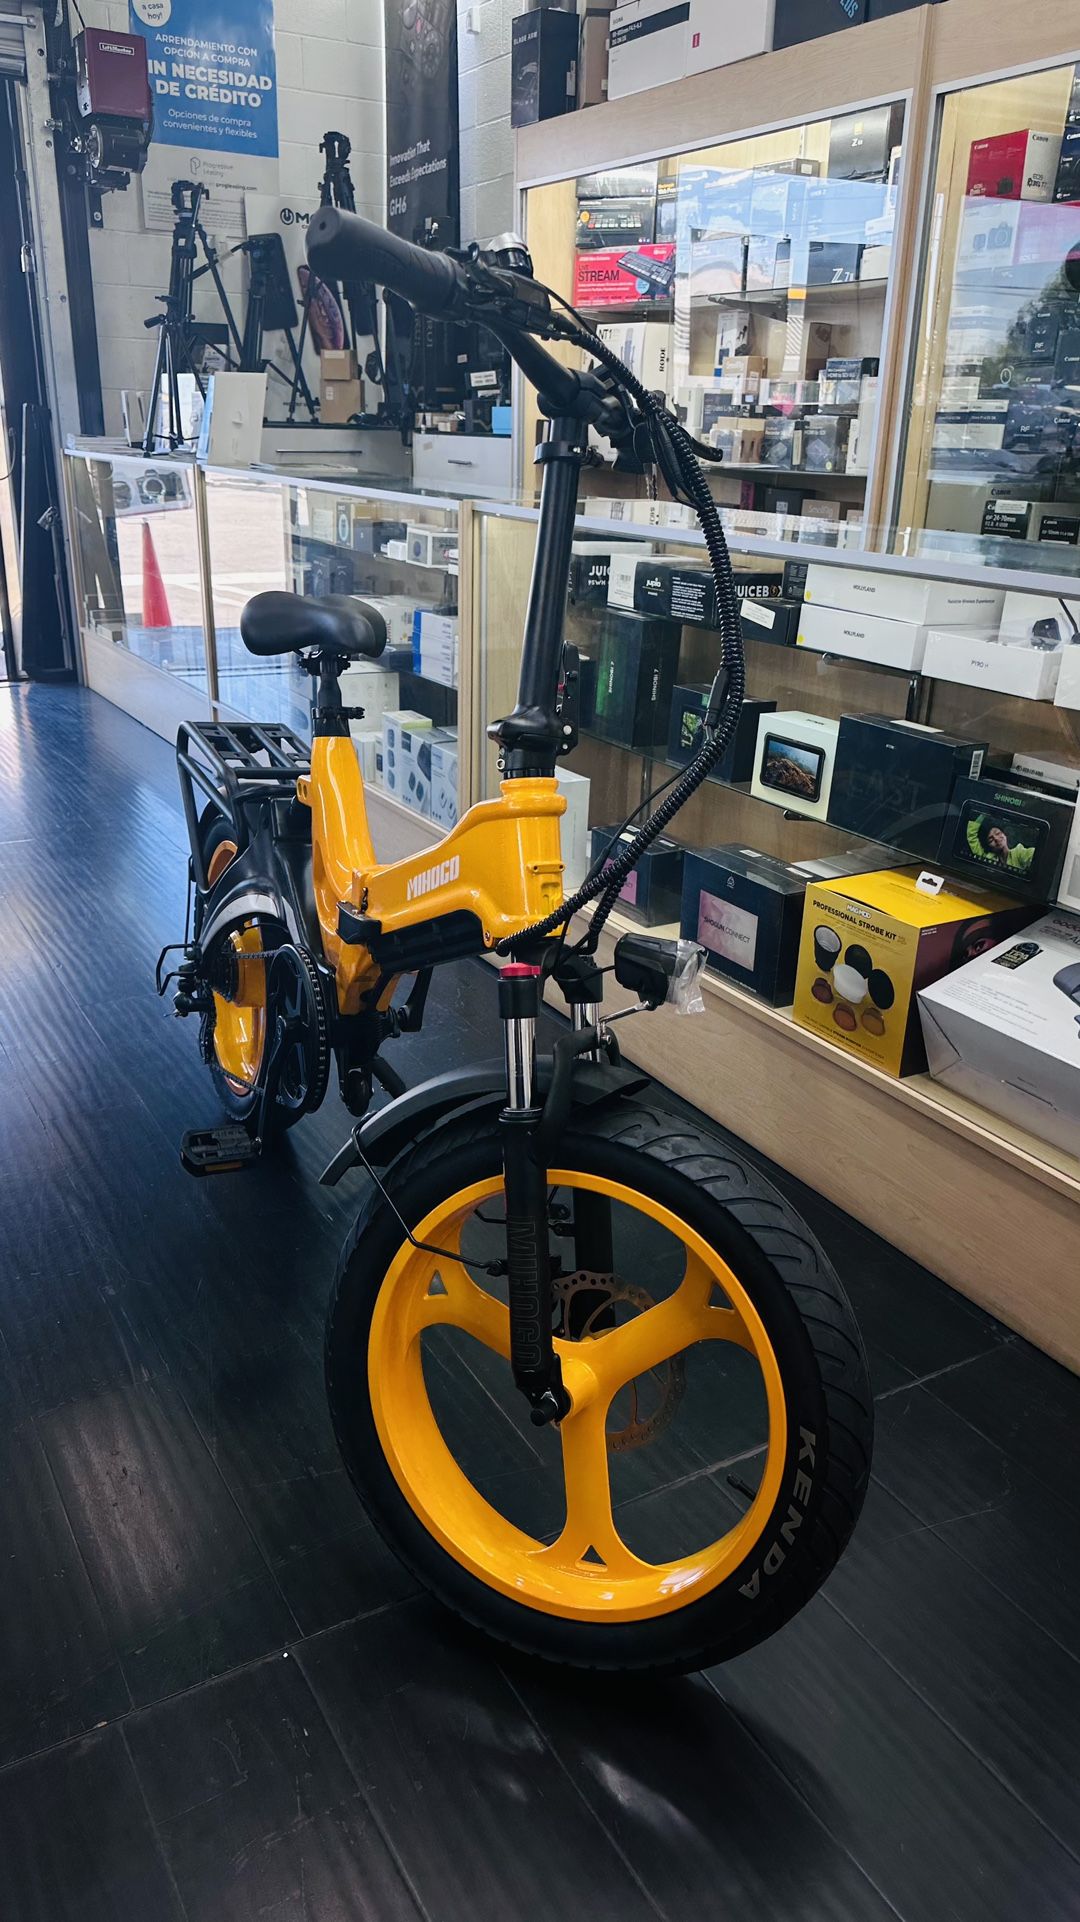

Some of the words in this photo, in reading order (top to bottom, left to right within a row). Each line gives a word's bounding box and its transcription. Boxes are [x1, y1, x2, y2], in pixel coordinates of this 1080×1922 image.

[147, 12, 163, 20] hoy!
[840, 0, 859, 18] US
[155, 34, 235, 54] ARRENDAMIENTO
[237, 47, 258, 57] CON
[163, 46, 200, 60] OPCIÓN
[201, 52, 210, 62] A
[211, 54, 251, 67] COMPRA
[148, 59, 167, 76] IN
[172, 64, 273, 91] NECESIDAD
[156, 80, 181, 97] DE
[185, 84, 262, 108] CRÉDITO
[162, 120, 217, 133] convenientes
[218, 127, 224, 136] y
[225, 127, 258, 138] flexibles
[168, 108, 207, 121] Opciones
[208, 114, 219, 123] de
[221, 116, 252, 128] compra
[390, 195, 407, 216] GH6
[578, 270, 620, 282] STREAM
[651, 674, 659, 701] SHINOBI
[993, 793, 1022, 806] SHINOBI
[406, 855, 460, 901] MIHOGO
[703, 915, 725, 932] SHOGUN
[725, 927, 751, 944] CONNECT
[812, 900, 857, 925] PROFESSIONAL
[858, 918, 885, 936] STROBE
[885, 929, 897, 941] KIT
[507, 1215, 542, 1368] MIHOGO
[738, 1425, 816, 1600] KENDA
